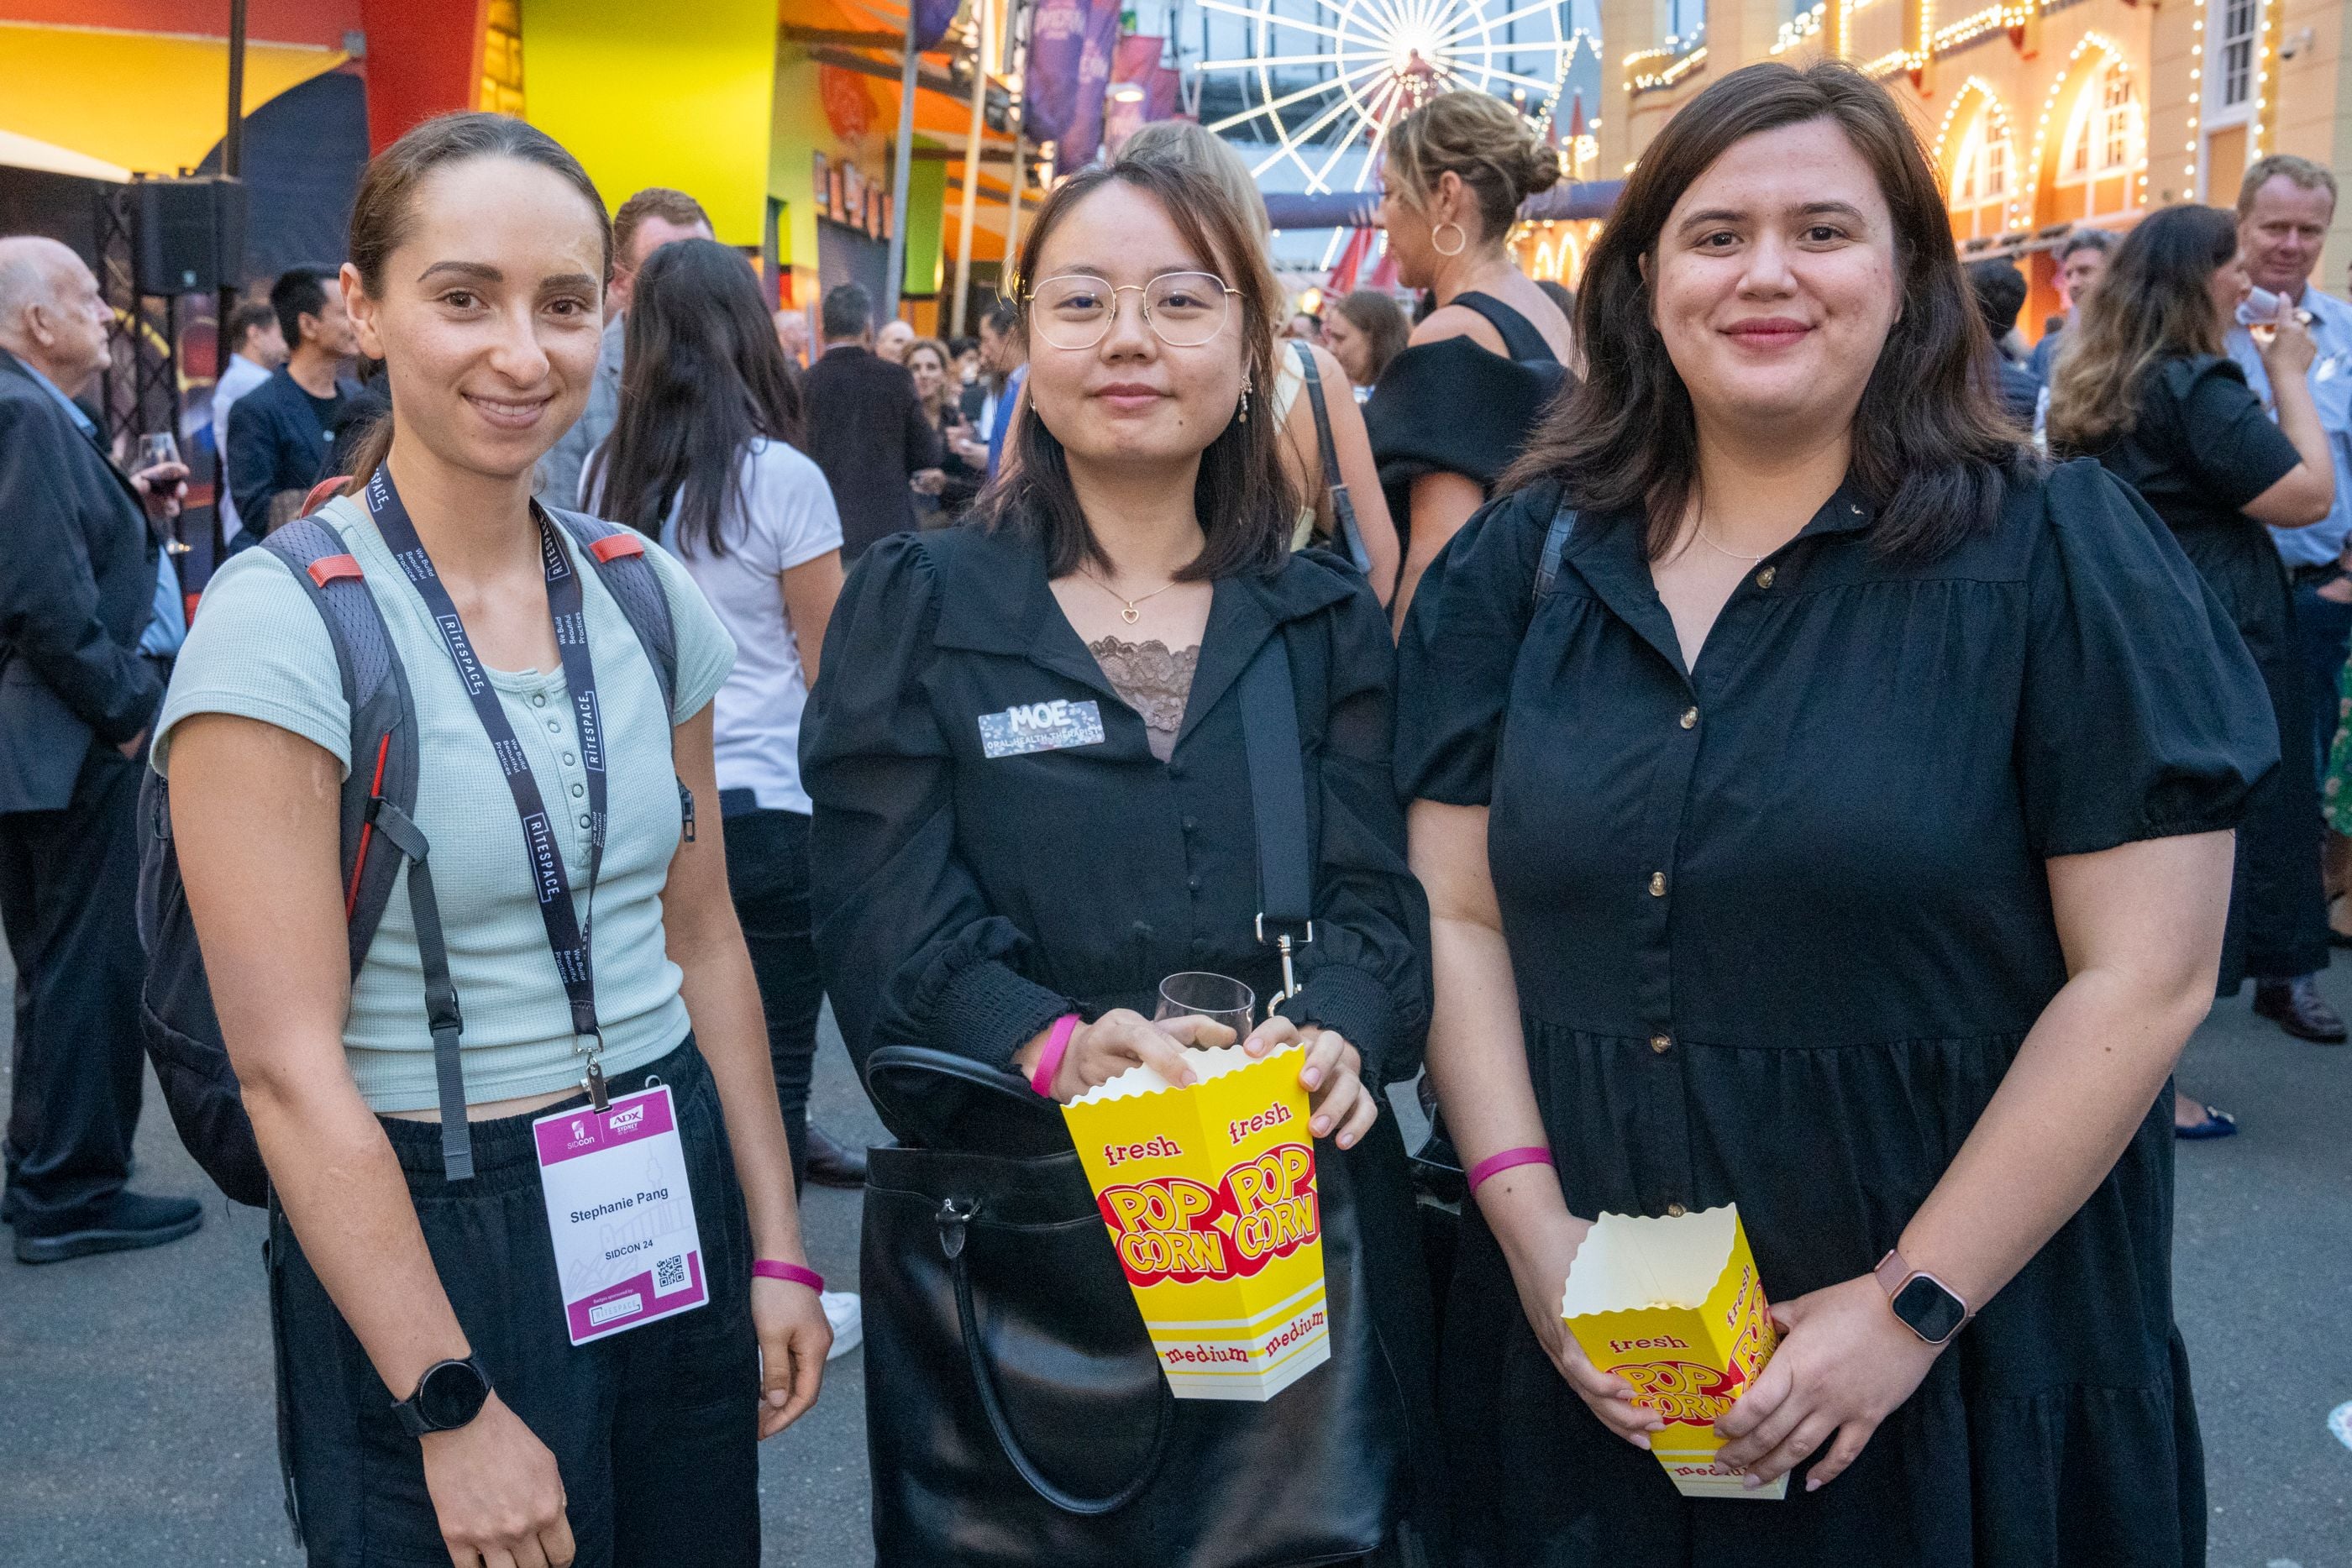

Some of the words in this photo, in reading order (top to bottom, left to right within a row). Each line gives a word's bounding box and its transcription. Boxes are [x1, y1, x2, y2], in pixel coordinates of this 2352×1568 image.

[396, 553, 417, 581] Practices
[406, 551, 427, 579] Beautiful
[415, 548, 424, 559] We
[422, 559, 435, 577] Build
[555, 616, 564, 633] Build
[560, 632, 566, 645] We
[565, 615, 576, 644] Beautiful
[575, 612, 585, 644] Practices
[445, 621, 485, 688] RITESPACE
[579, 695, 598, 763] RITESPACE
[1010, 700, 1072, 732] MOE
[511, 739, 518, 750] We
[516, 752, 527, 770] Build
[987, 740, 1009, 750] ORAL
[1013, 735, 1047, 746] HEALTH
[1050, 727, 1100, 740] THERAPIST
[496, 742, 512, 775] Practices
[503, 741, 521, 773] Beautiful
[531, 821, 560, 895] RITESPACE
[555, 952, 569, 983] Practices
[564, 951, 578, 982] Beautiful
[574, 949, 580, 961] We
[577, 962, 586, 981] Build
[614, 1111, 642, 1125] ADX
[617, 1123, 638, 1132] SYDNEY
[1228, 1102, 1292, 1144] fresh
[567, 1136, 595, 1150] SIDcon
[1105, 1136, 1182, 1166] fresh
[1227, 1148, 1310, 1216] POP
[571, 1198, 633, 1223] Stephanie
[637, 1188, 669, 1204] Pang
[1109, 1183, 1210, 1233] POP
[1235, 1194, 1315, 1258] CORN
[606, 1242, 641, 1260] SIDCON
[643, 1240, 654, 1249] 24
[1121, 1231, 1226, 1273] CORN
[1727, 1263, 1751, 1330] fresh
[1265, 1310, 1324, 1356] medium
[1610, 1335, 1690, 1353] fresh
[1733, 1285, 1765, 1378] POP
[1165, 1345, 1249, 1363] medium
[1613, 1363, 1721, 1395] POP
